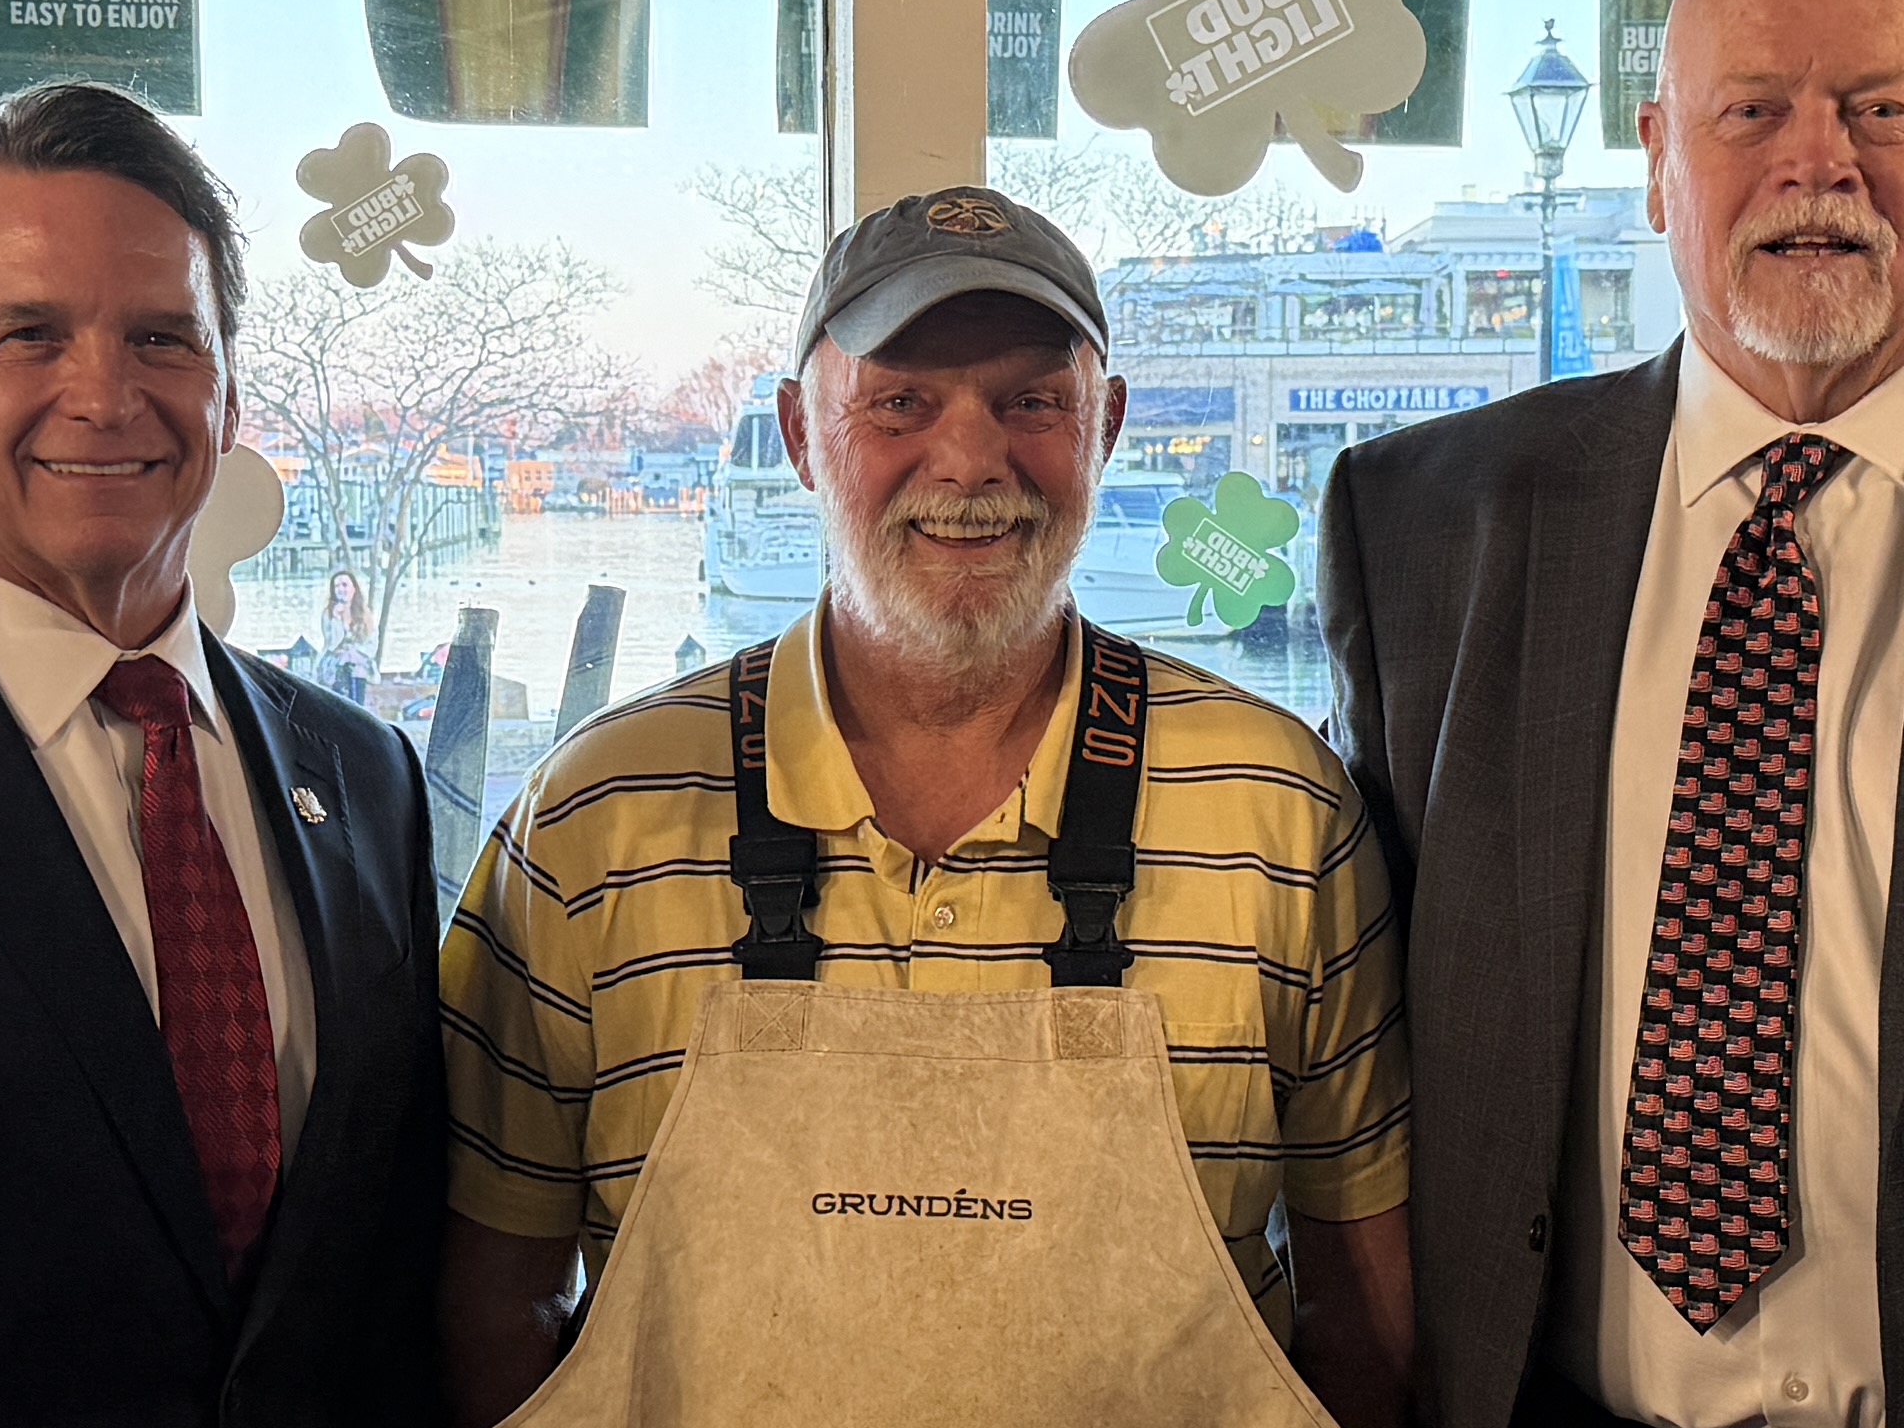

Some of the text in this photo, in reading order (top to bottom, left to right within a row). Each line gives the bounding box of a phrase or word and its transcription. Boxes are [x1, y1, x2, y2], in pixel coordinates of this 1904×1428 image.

[10, 1, 179, 29] EASY TO ENJOY
[989, 35, 1042, 58] NJOY
[1618, 50, 1658, 73] LIG
[1298, 389, 1337, 409] THE
[812, 1188, 1033, 1220] GRUNDÉNS
